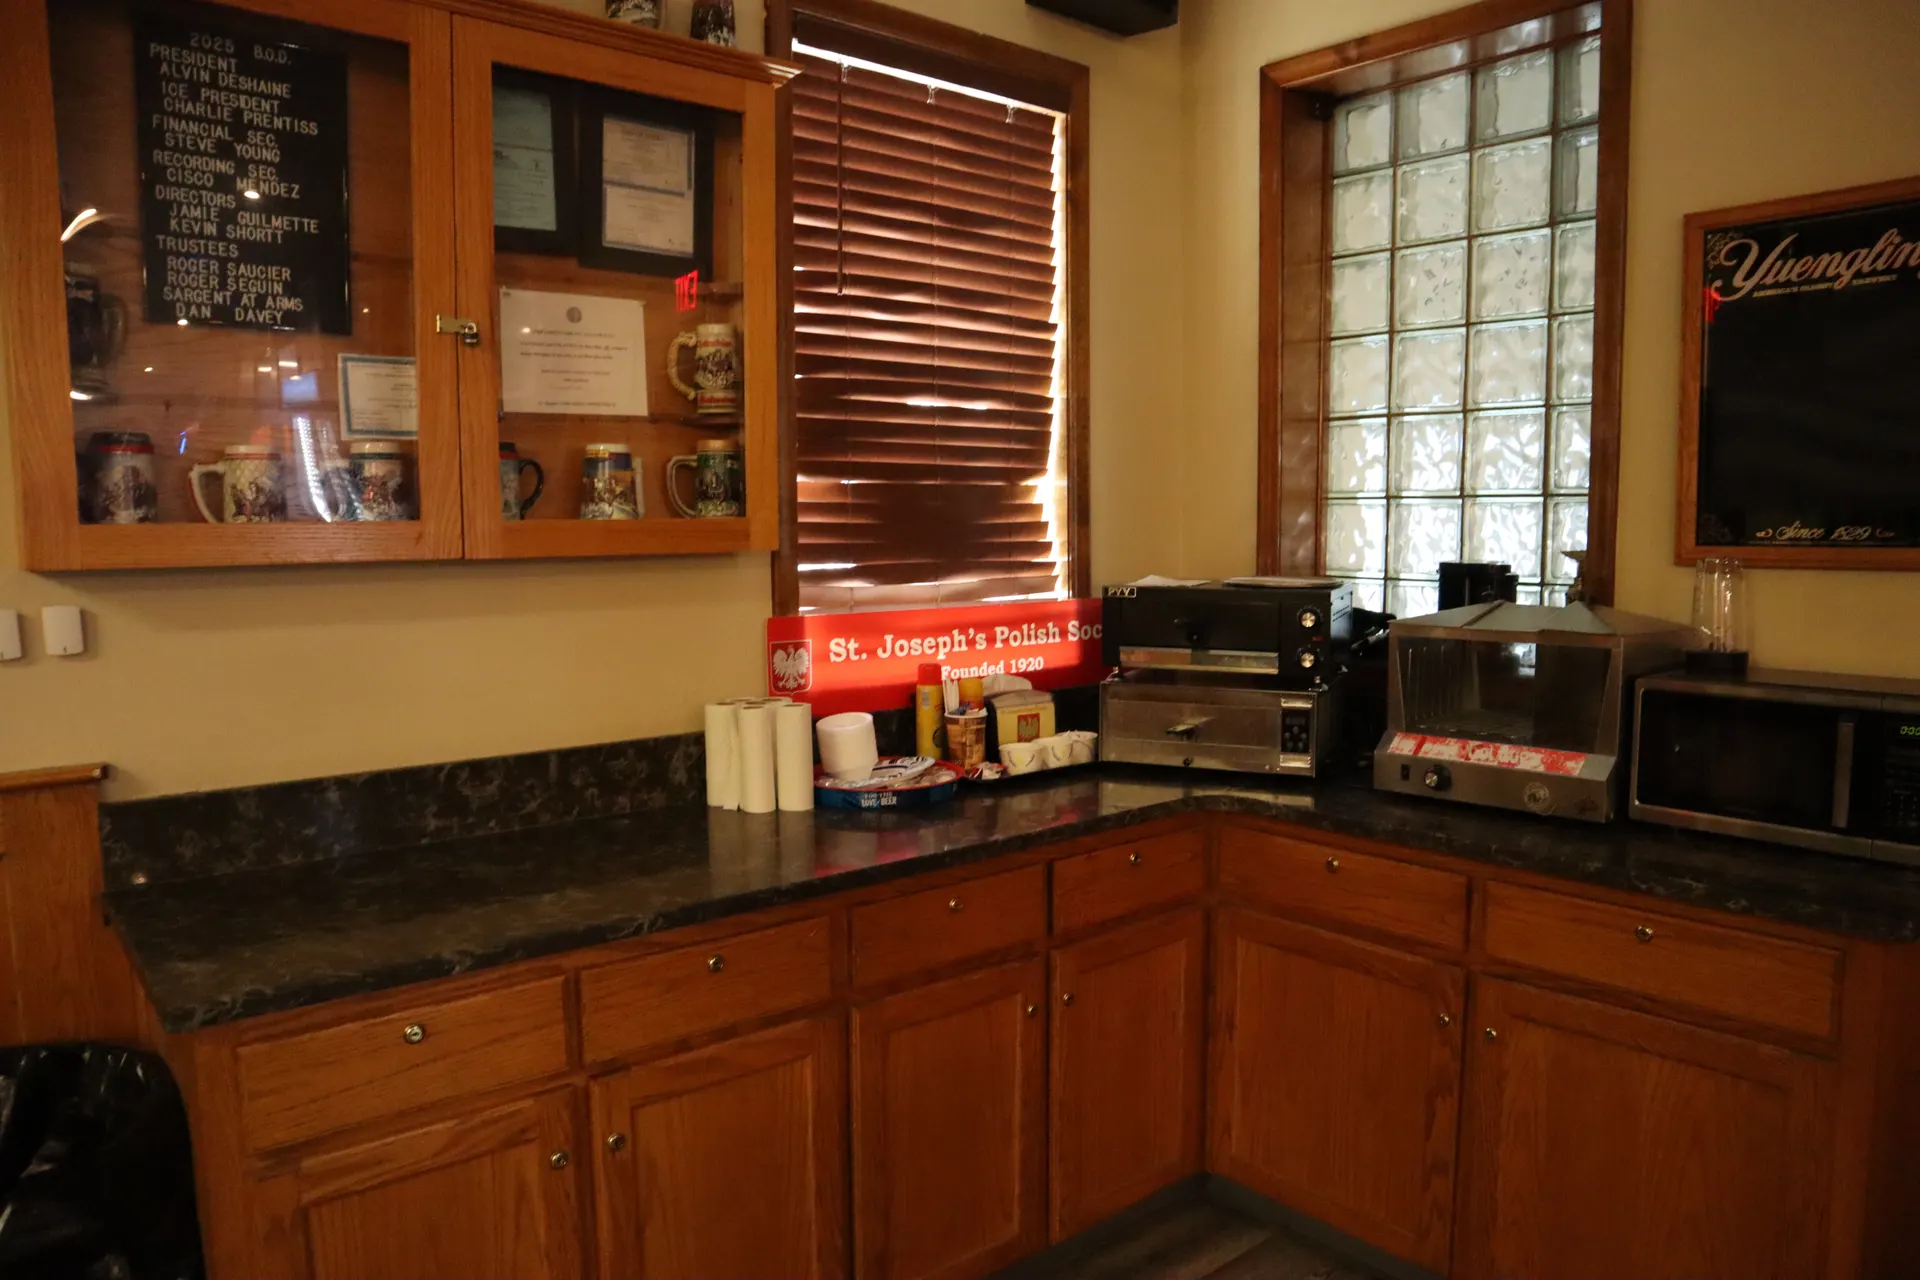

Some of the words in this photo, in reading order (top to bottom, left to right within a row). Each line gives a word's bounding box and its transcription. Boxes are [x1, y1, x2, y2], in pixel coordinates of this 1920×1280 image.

[150, 42, 238, 73] PRESIDENT
[160, 62, 211, 83] ALVIN
[218, 72, 292, 98] DESHAINE
[201, 88, 280, 113] PRESIDENT
[163, 97, 233, 122] CHARLIE
[243, 111, 318, 135] PRENTISS
[152, 115, 234, 141] FINANCIAL
[247, 130, 278, 148] SEC.
[165, 133, 216, 153] STEVE
[234, 143, 281, 163] YOUNG
[153, 150, 235, 175] RECORDING
[248, 164, 279, 180] SEC.
[155, 184, 236, 209] DIRECTORS
[167, 168, 214, 187] CISCO
[236, 177, 300, 199] MENDEZ
[169, 203, 220, 222] JAMIE
[238, 210, 319, 234] GUILMETTE
[170, 218, 217, 237] KEVIN
[226, 224, 284, 244] SHORTT
[156, 235, 239, 258] TRUSTEES
[167, 255, 219, 275] ROGER
[227, 262, 291, 281] SAUCIER
[1711, 227, 1920, 301] Yuenglin
[167, 271, 219, 290] ROGER
[227, 278, 283, 295] SEGUIN
[163, 286, 233, 306] SARGENT
[240, 293, 256, 308] AT
[265, 297, 303, 312] ARMS
[176, 302, 211, 319] DAN
[235, 308, 284, 325] DAVEY
[1775, 520, 1825, 540] Since
[829, 637, 867, 663] St.
[877, 627, 987, 661] Joseph's
[995, 621, 1060, 650] Polish
[941, 660, 1005, 681] Founded
[1010, 657, 1044, 673] 1920
